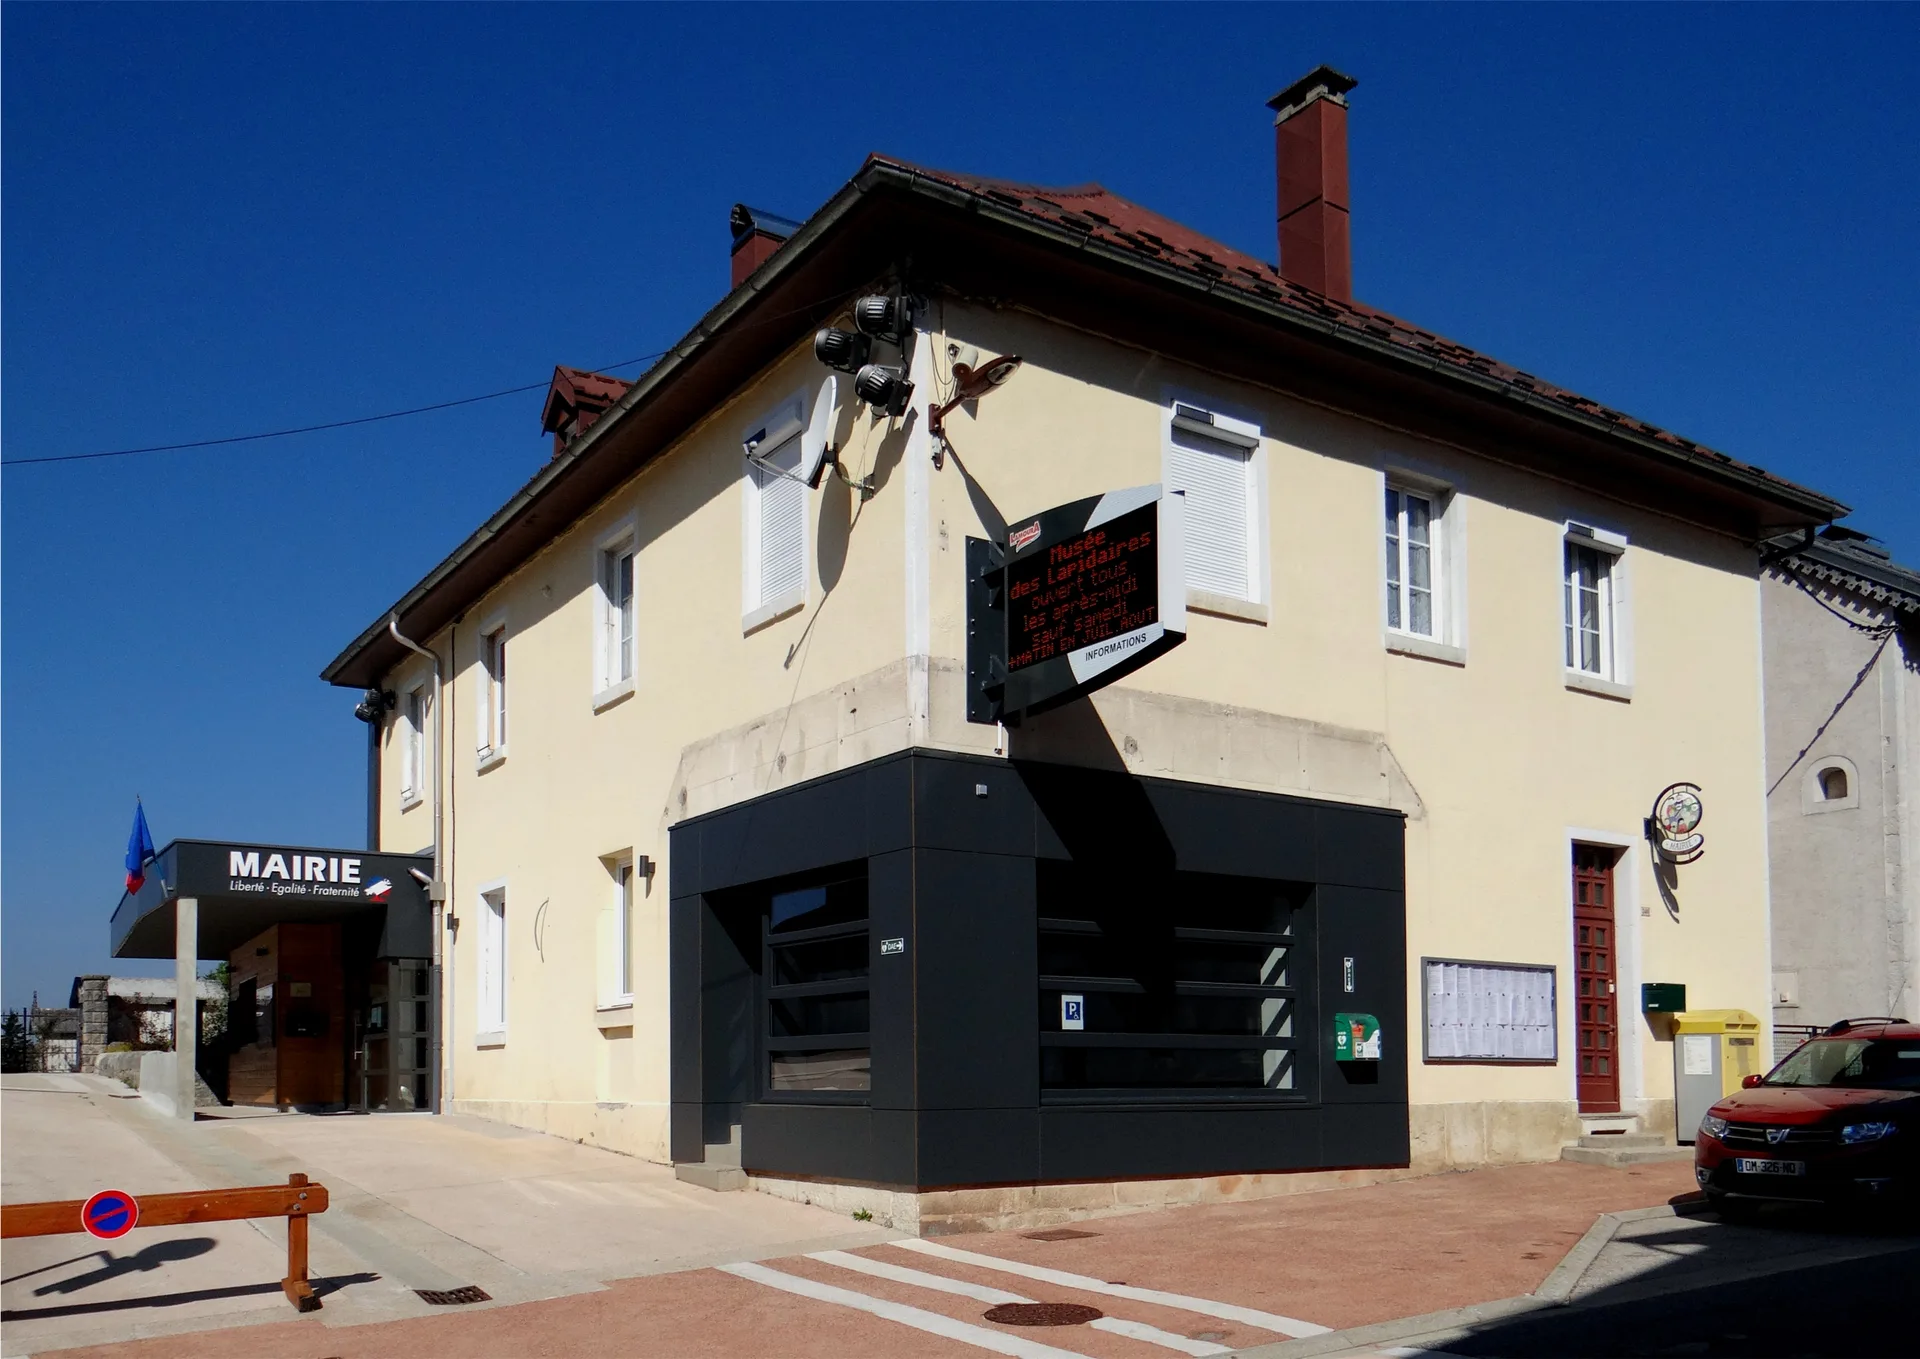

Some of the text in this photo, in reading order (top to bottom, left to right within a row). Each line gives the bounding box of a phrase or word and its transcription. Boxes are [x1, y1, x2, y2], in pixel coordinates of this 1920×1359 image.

[1050, 531, 1106, 565] Musée
[1010, 531, 1151, 600] des Lapidaires
[1032, 561, 1128, 610] ouvert tous
[1023, 612, 1046, 632] les
[1032, 596, 1128, 647] sauf samedi
[1060, 635, 1075, 651] EN
[1085, 633, 1147, 661] INFORMATIONS
[230, 851, 361, 884] MAIRIE
[229, 880, 265, 892] Liberté
[271, 882, 306, 896] Egalité
[313, 885, 360, 897] Fraternité
[1069, 1003, 1077, 1015] P
